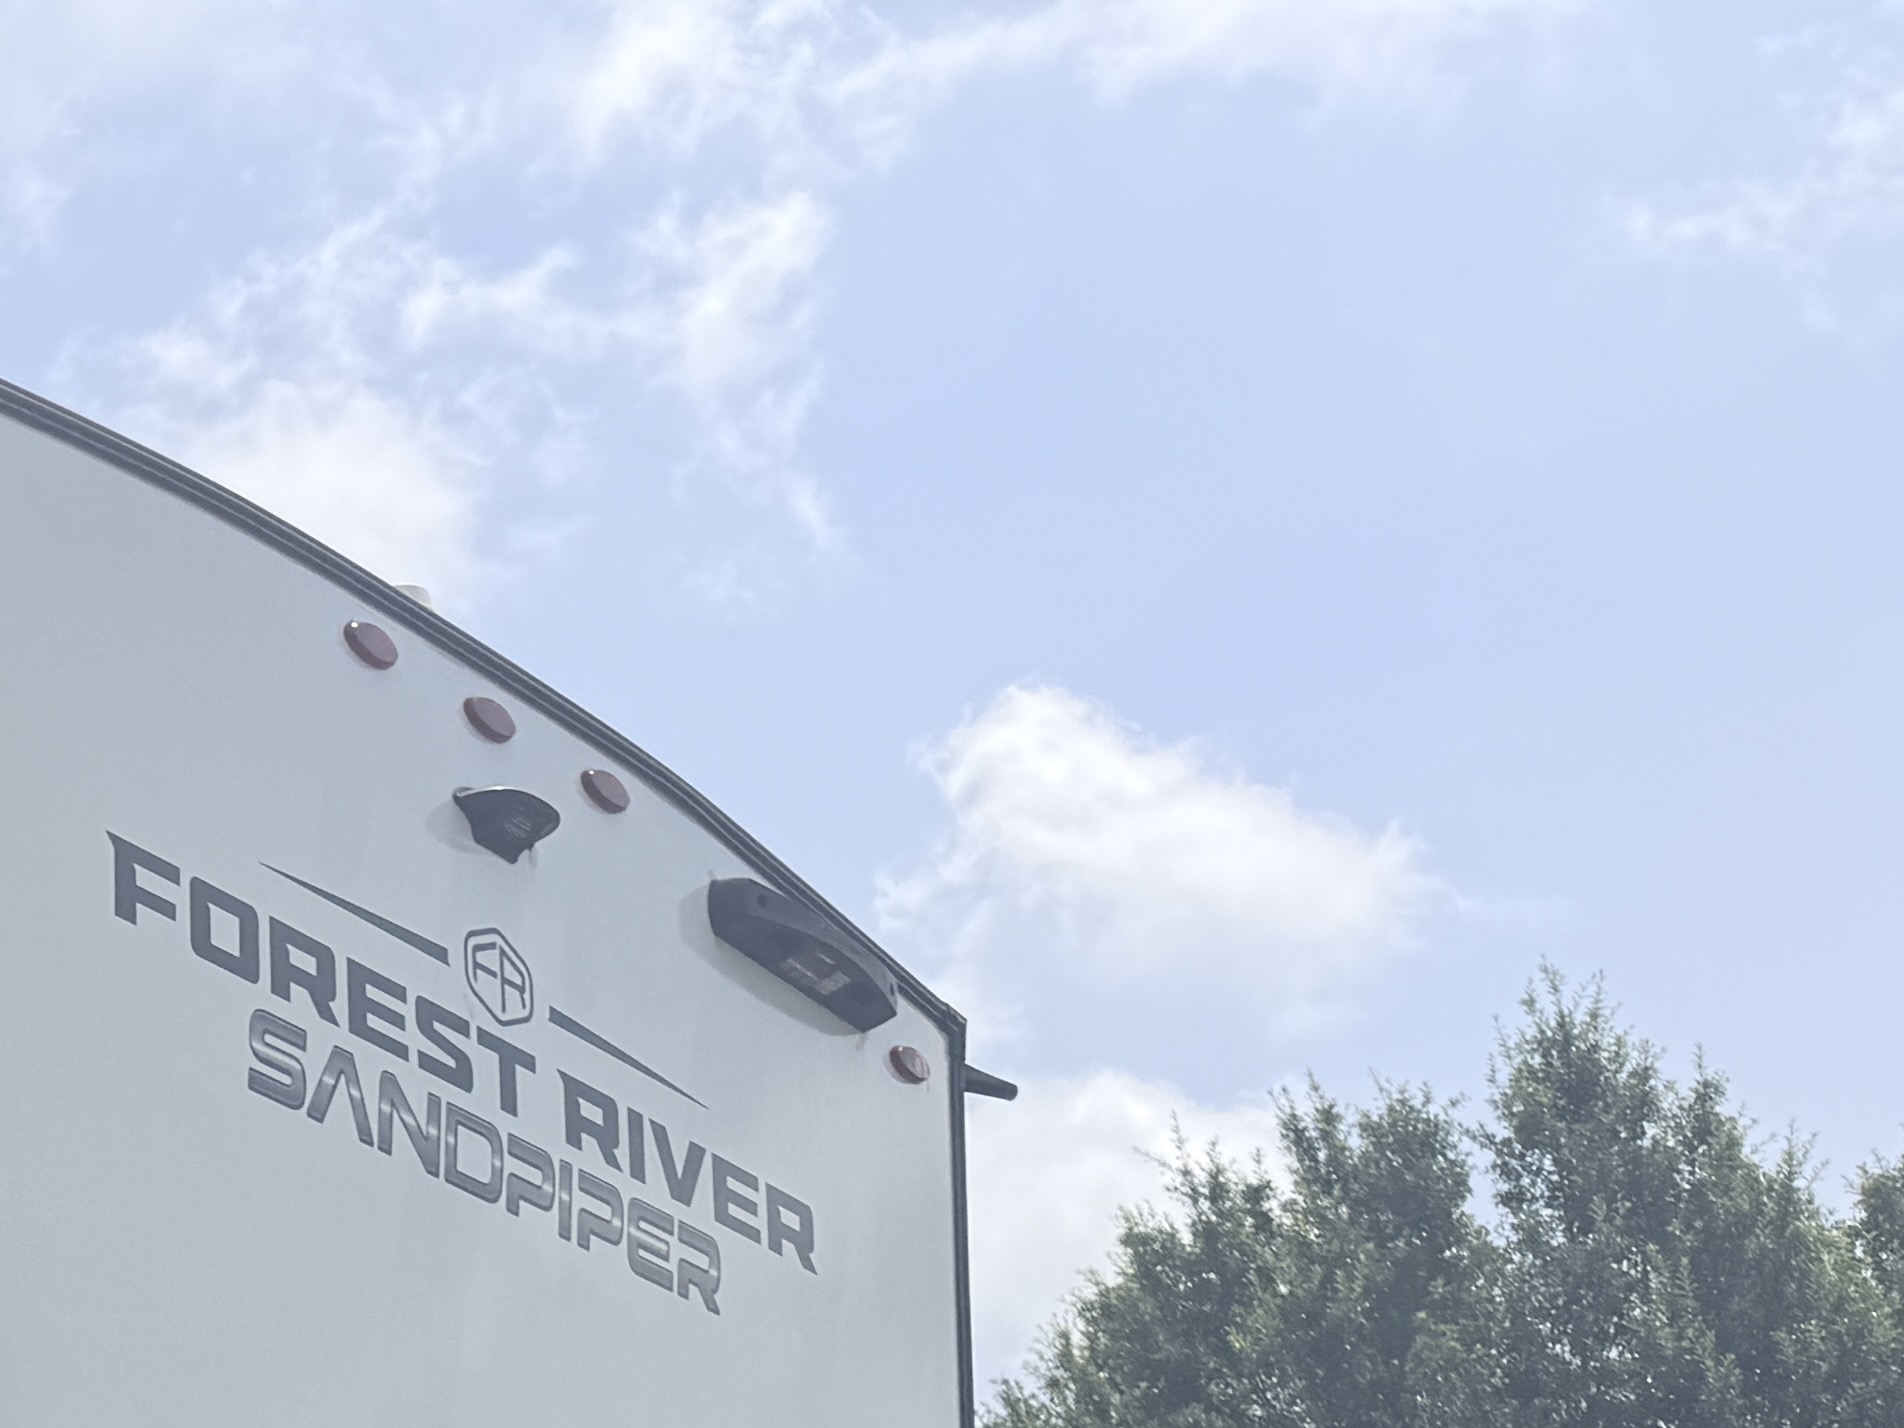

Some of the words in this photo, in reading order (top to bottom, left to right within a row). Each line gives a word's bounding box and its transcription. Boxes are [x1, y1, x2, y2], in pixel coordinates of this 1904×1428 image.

[106, 830, 537, 1117] FOREST
[558, 1069, 818, 1275] RIVER
[247, 1009, 722, 1316] SANDPIPER
